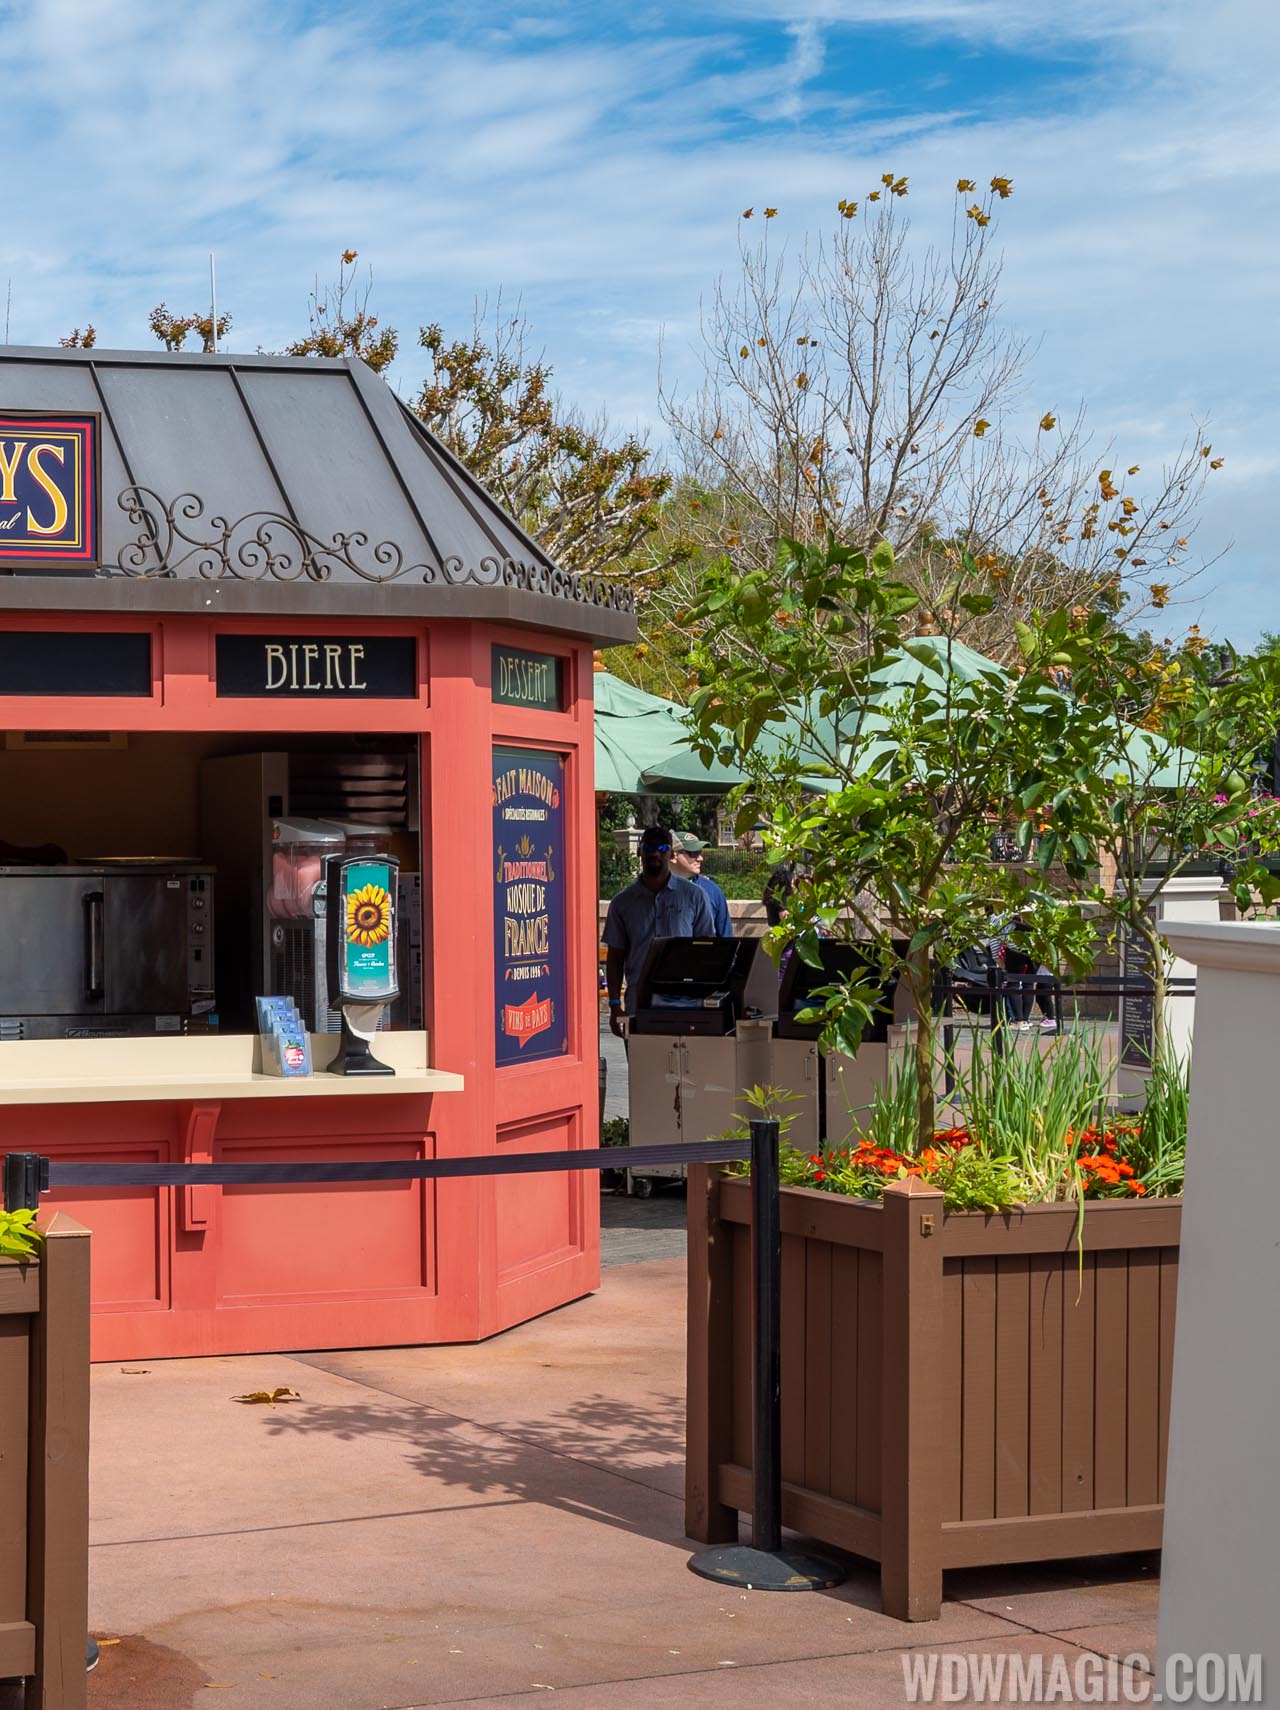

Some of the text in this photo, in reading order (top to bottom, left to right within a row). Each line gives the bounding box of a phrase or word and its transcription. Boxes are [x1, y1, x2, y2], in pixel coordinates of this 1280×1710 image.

[264, 644, 368, 690] BIERE
[499, 655, 549, 703] DESSERT
[495, 767, 554, 807] FAIT MAISON
[506, 883, 546, 917] KIOSQUE DE
[504, 914, 549, 957] FRANCE
[513, 966, 530, 981] DEPUIS
[508, 1008, 524, 1031] VINS
[531, 1003, 548, 1029] PAYS
